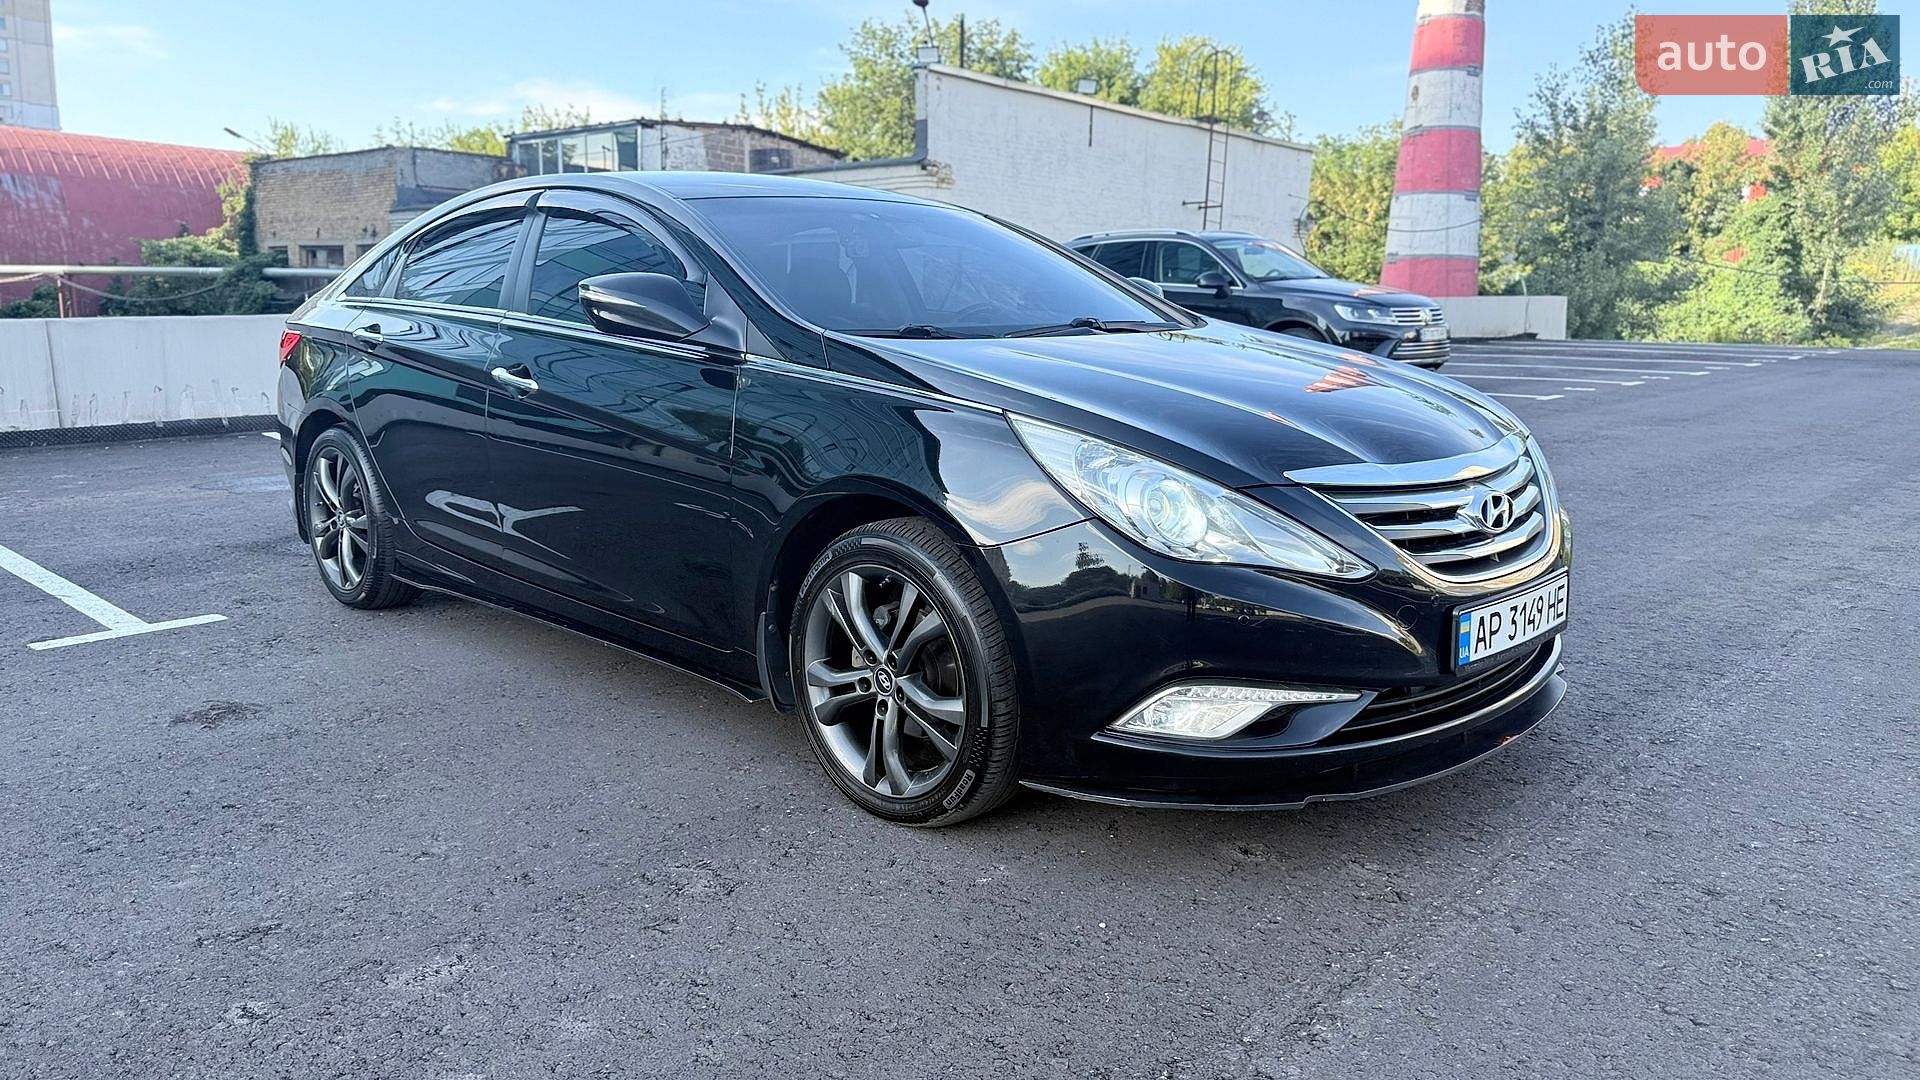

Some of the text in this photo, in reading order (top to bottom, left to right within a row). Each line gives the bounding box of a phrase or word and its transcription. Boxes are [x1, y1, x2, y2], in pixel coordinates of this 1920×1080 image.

[1474, 584, 1565, 654] AP 3149 HE
[1460, 646, 1469, 659] UA
[945, 773, 974, 805] RoadFun
